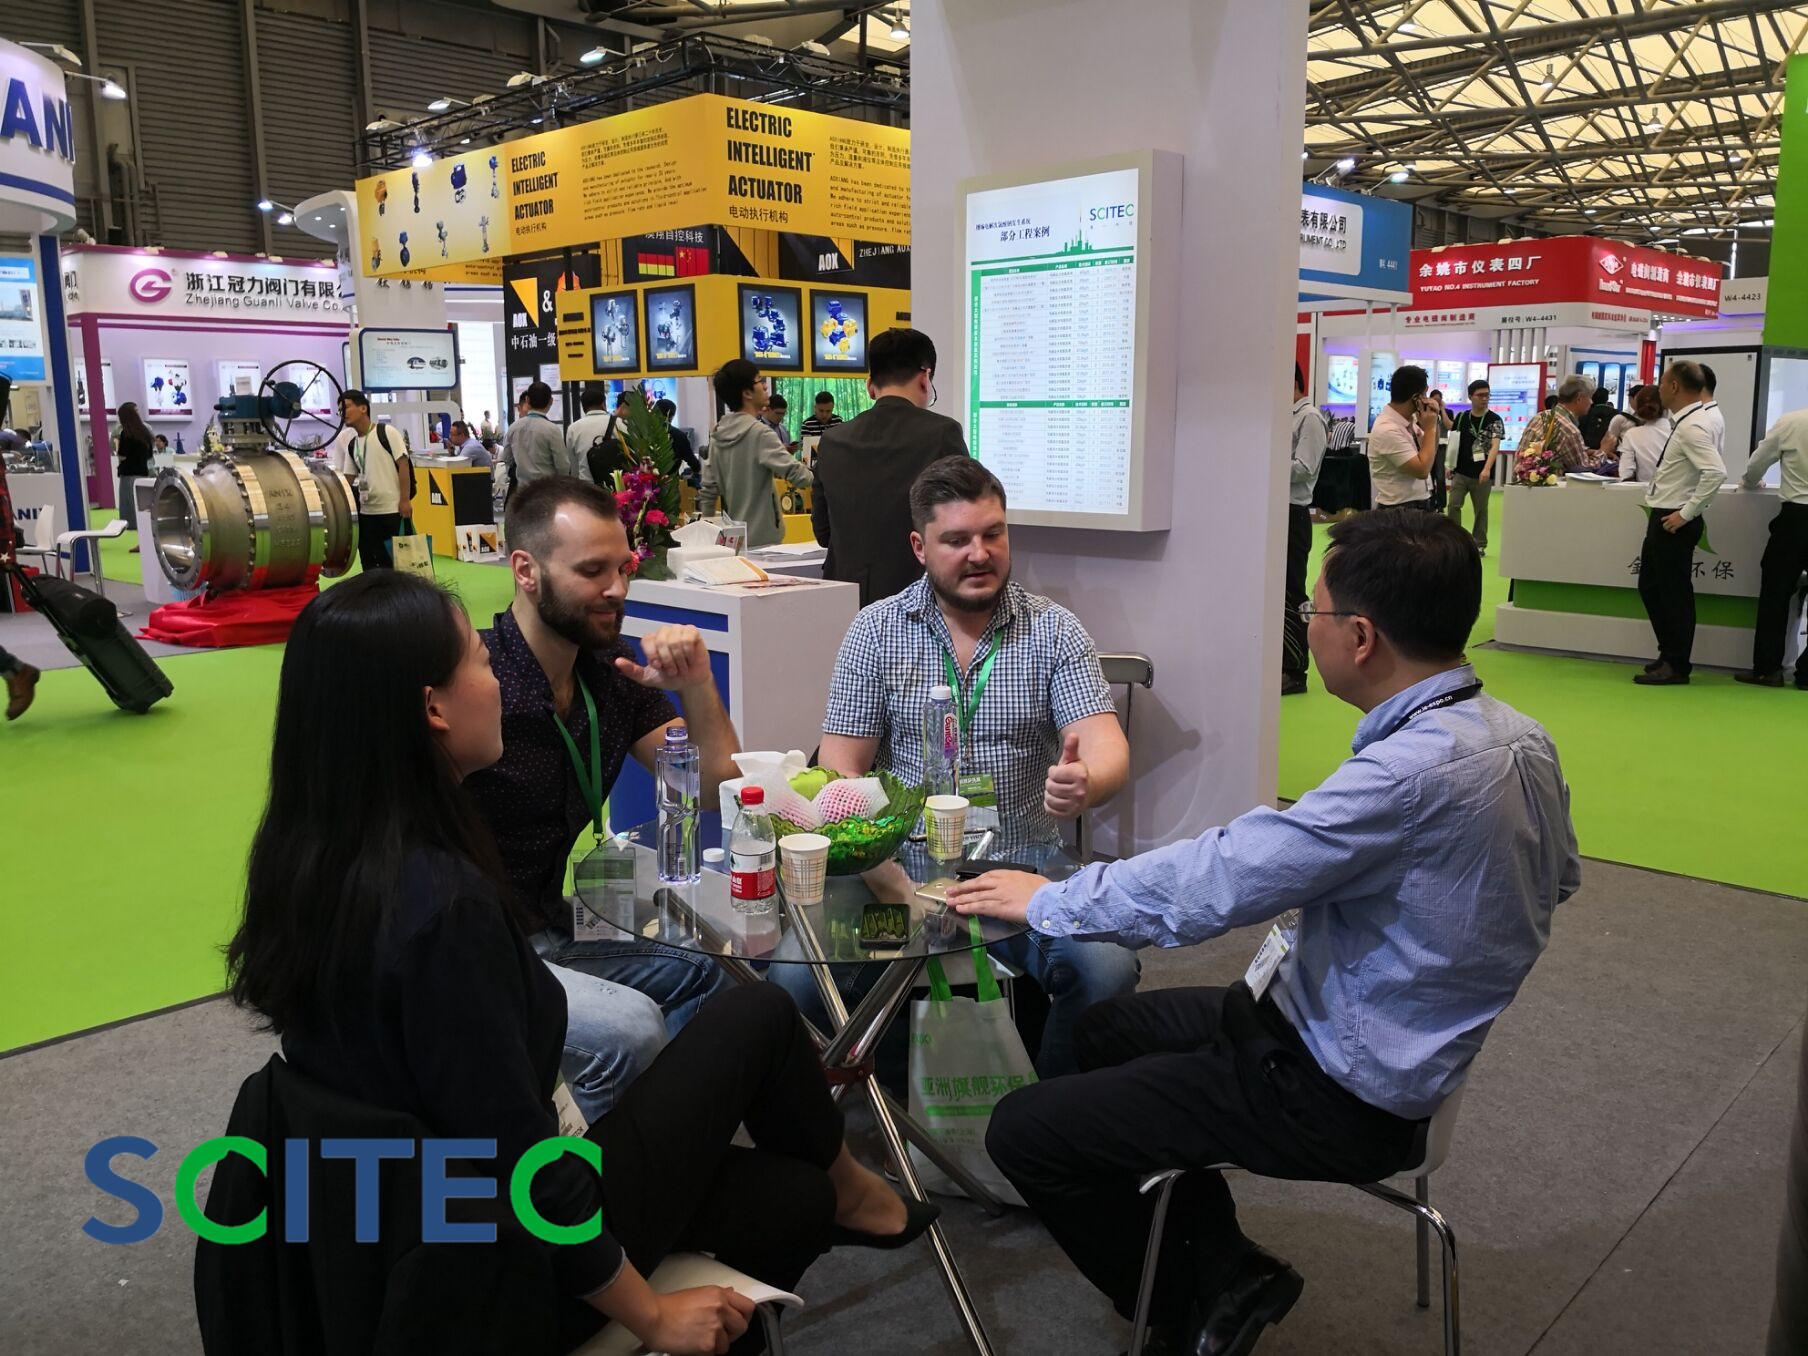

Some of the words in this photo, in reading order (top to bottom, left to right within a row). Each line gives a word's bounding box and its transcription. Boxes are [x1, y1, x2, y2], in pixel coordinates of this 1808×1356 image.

[726, 106, 792, 138] ELECTRIC
[511, 151, 546, 174] ELECTRIC
[727, 139, 813, 172] INTELLIGENT
[513, 172, 558, 196] INTELLIGENT
[728, 174, 802, 205] ACTUATOR
[515, 199, 554, 221] ACTUATOR
[729, 205, 788, 223] 电动执行机构
[1089, 203, 1135, 221] SCITEC
[1301, 208, 1347, 234] 表有限公司
[818, 252, 839, 272] AOX
[859, 245, 895, 258] ZHEJIANG
[1419, 256, 1542, 278] 余姚市仪表四厂
[1420, 285, 1442, 293] YUYAO
[1462, 281, 1505, 290] INSTRUMENT
[1507, 279, 1540, 287] FACTORY
[1724, 292, 1761, 302] W4-4423
[185, 293, 240, 308] Zhejiang
[243, 295, 282, 308] Guanli
[286, 298, 319, 310] Valve
[542, 290, 553, 312] &
